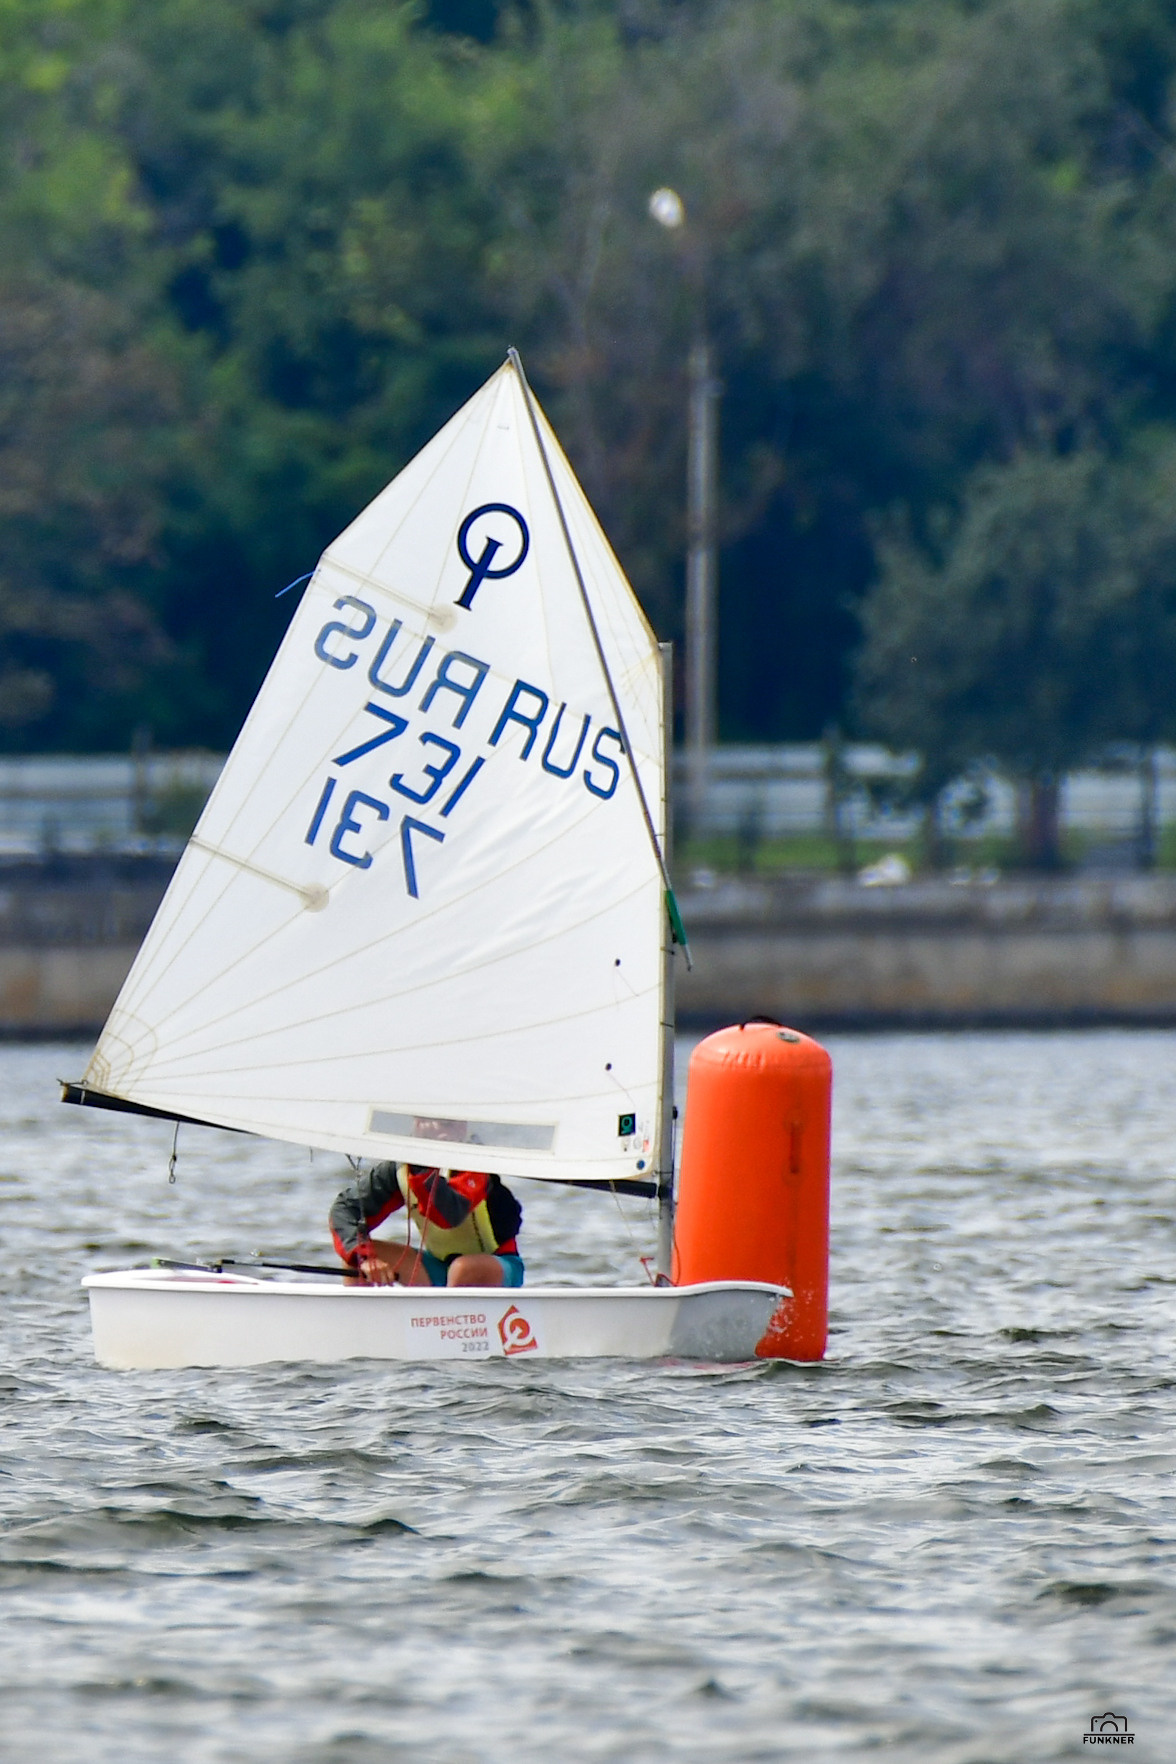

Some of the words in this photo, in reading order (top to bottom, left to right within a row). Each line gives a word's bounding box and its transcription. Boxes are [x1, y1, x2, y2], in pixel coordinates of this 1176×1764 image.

[487, 679, 627, 800] RUS
[331, 701, 486, 818] 731
[410, 1313, 487, 1328] ПЕРВЕНСТВО
[440, 1327, 488, 1340] РОССИИ
[461, 1341, 490, 1353] 2022
